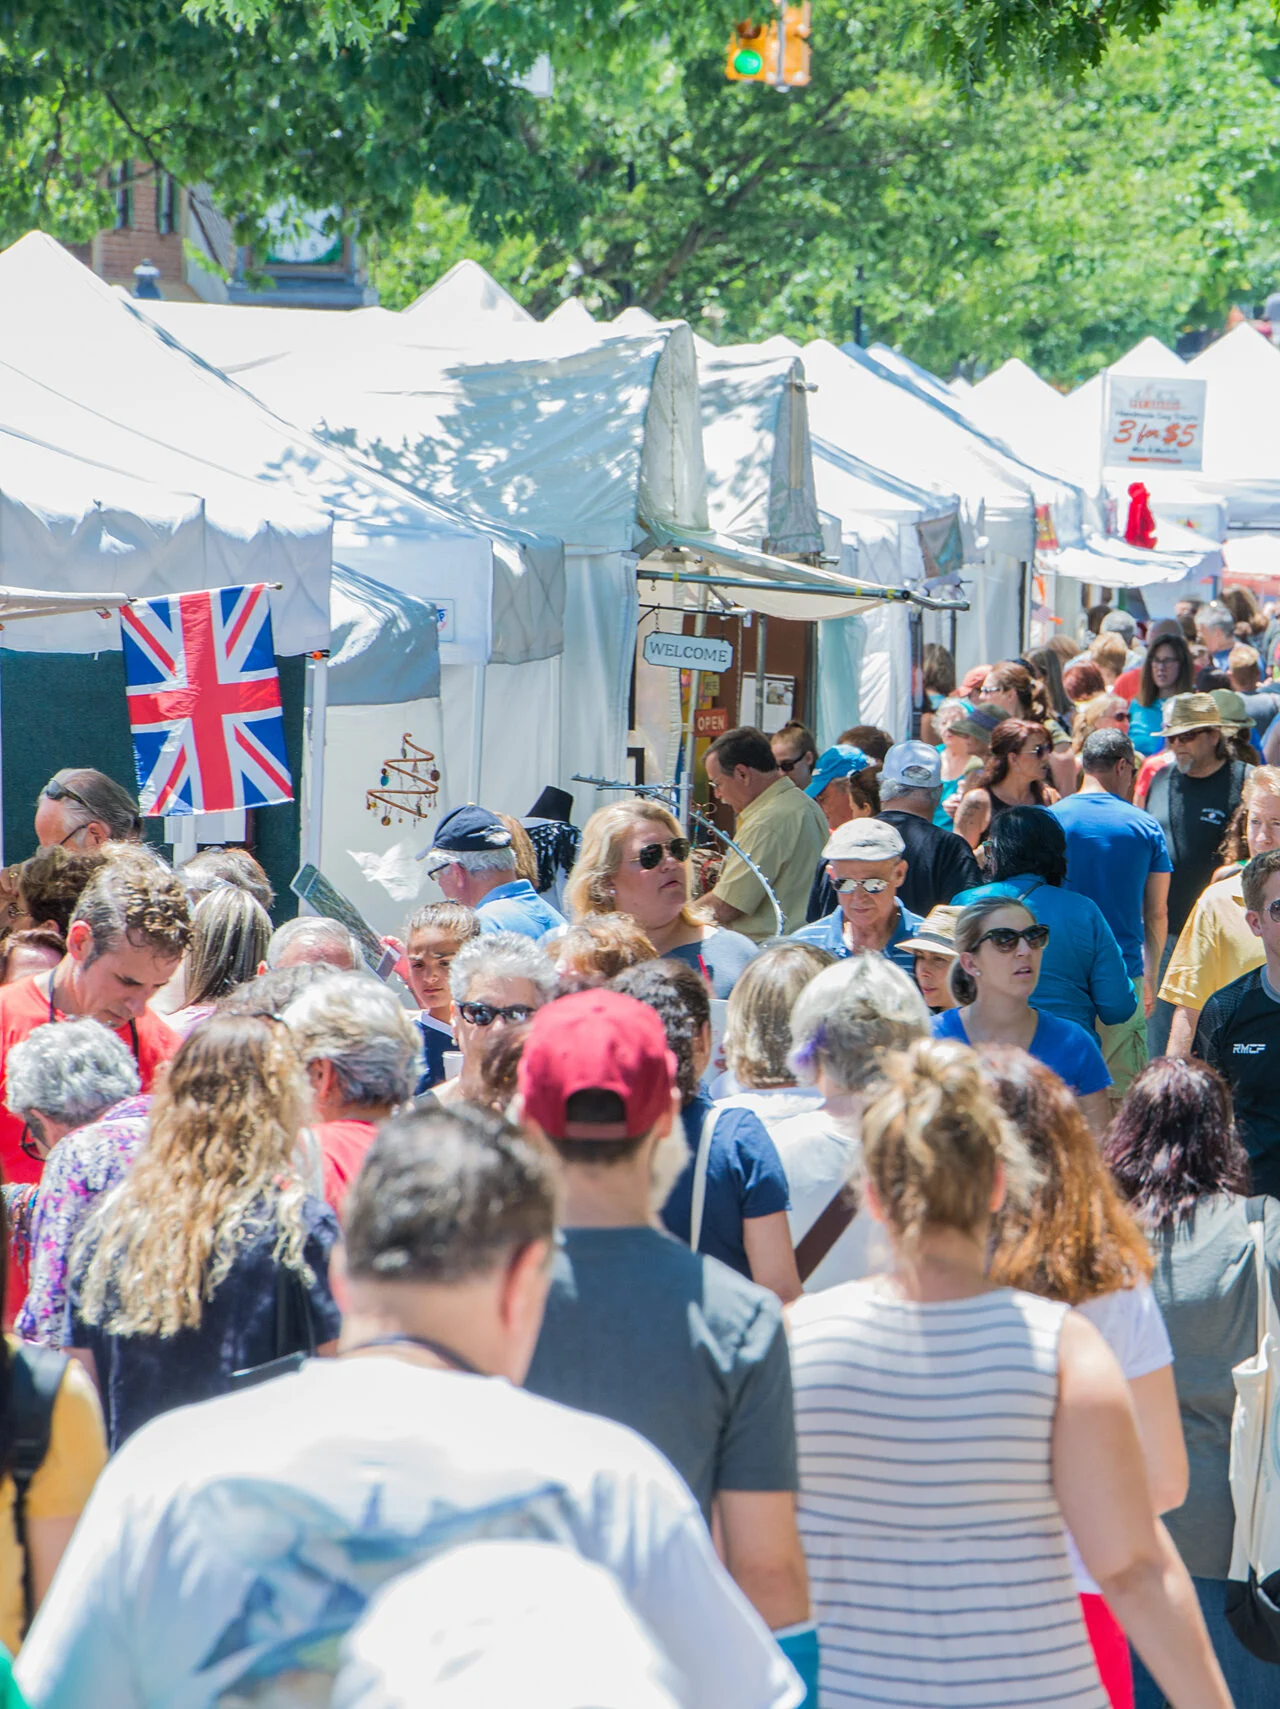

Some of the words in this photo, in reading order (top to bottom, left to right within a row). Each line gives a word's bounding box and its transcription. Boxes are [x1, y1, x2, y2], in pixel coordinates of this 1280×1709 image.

[1113, 419, 1137, 444] 3
[1162, 422, 1198, 448] $5
[649, 641, 728, 663] WELCOME
[697, 715, 725, 731] OPEN
[1232, 1043, 1267, 1054] RMCF
